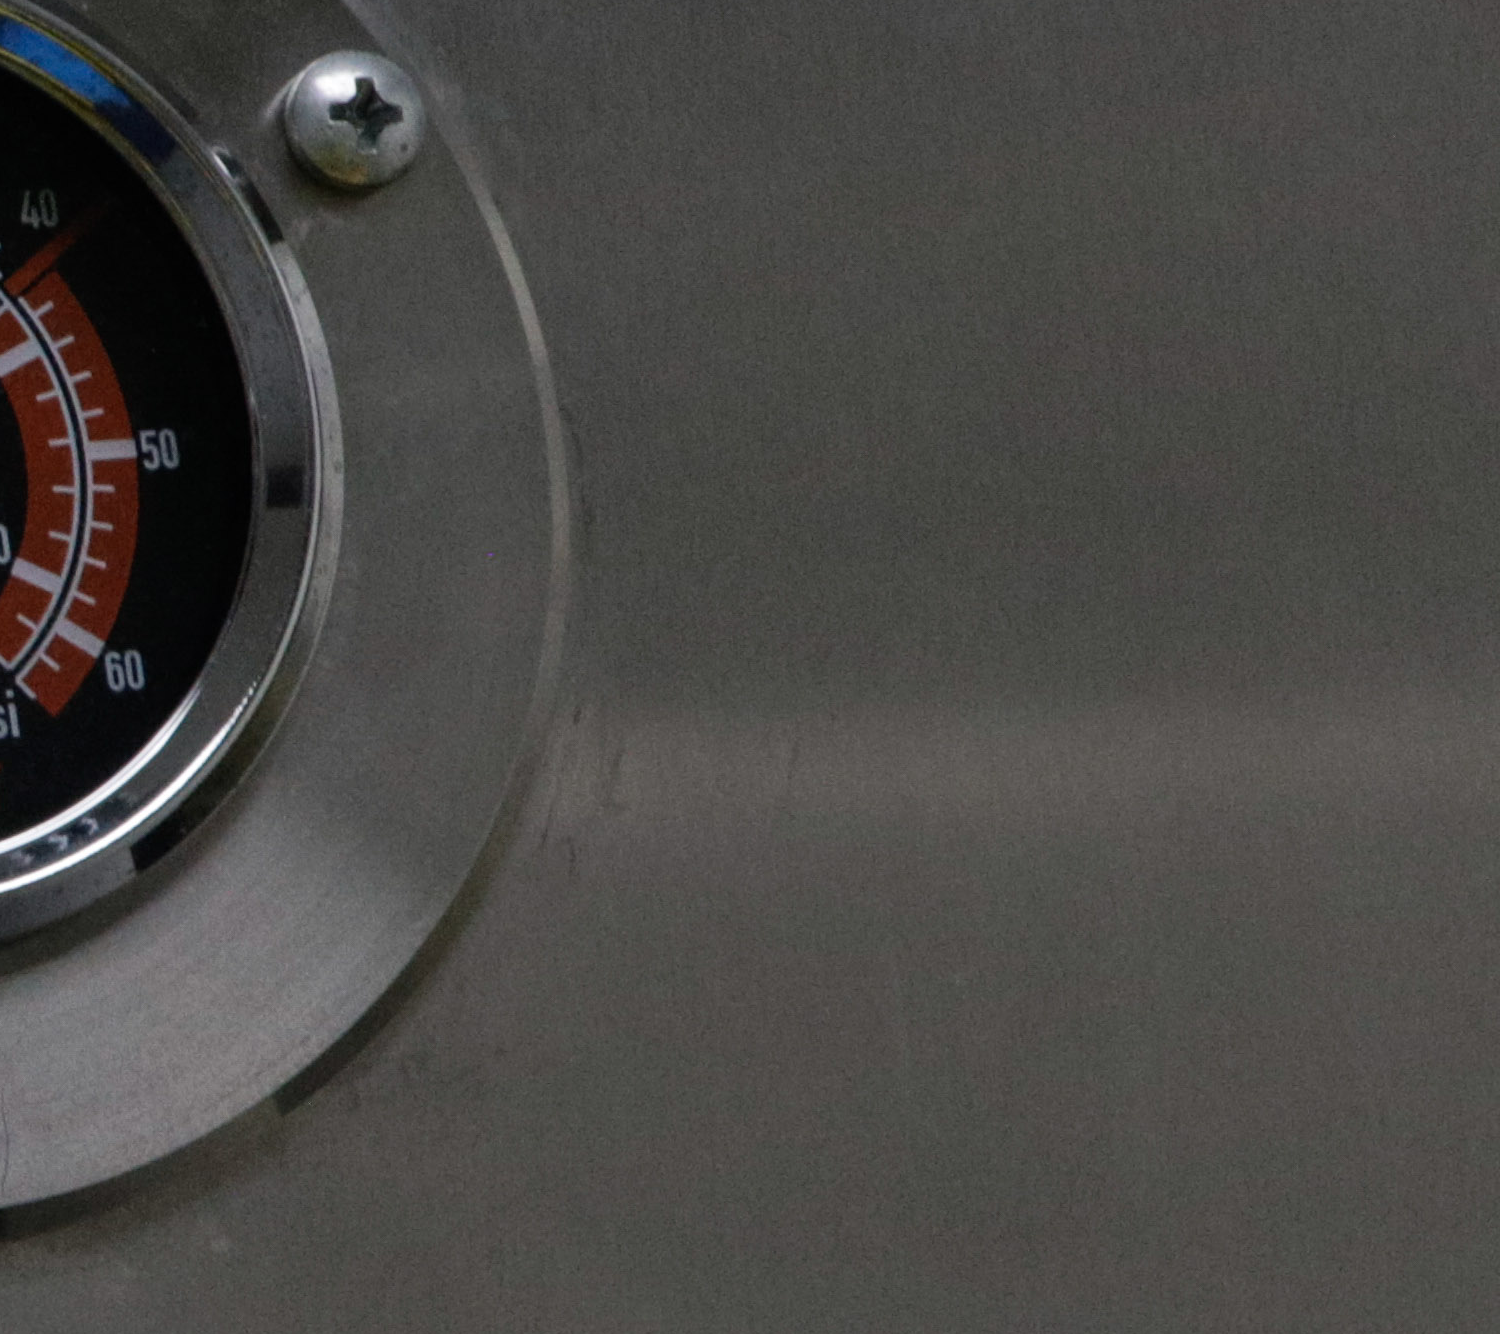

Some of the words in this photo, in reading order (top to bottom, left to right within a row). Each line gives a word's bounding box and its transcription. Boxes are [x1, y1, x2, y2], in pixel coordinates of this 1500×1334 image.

[21, 189, 59, 229] 40
[140, 429, 180, 469] 50
[104, 649, 146, 693] 60
